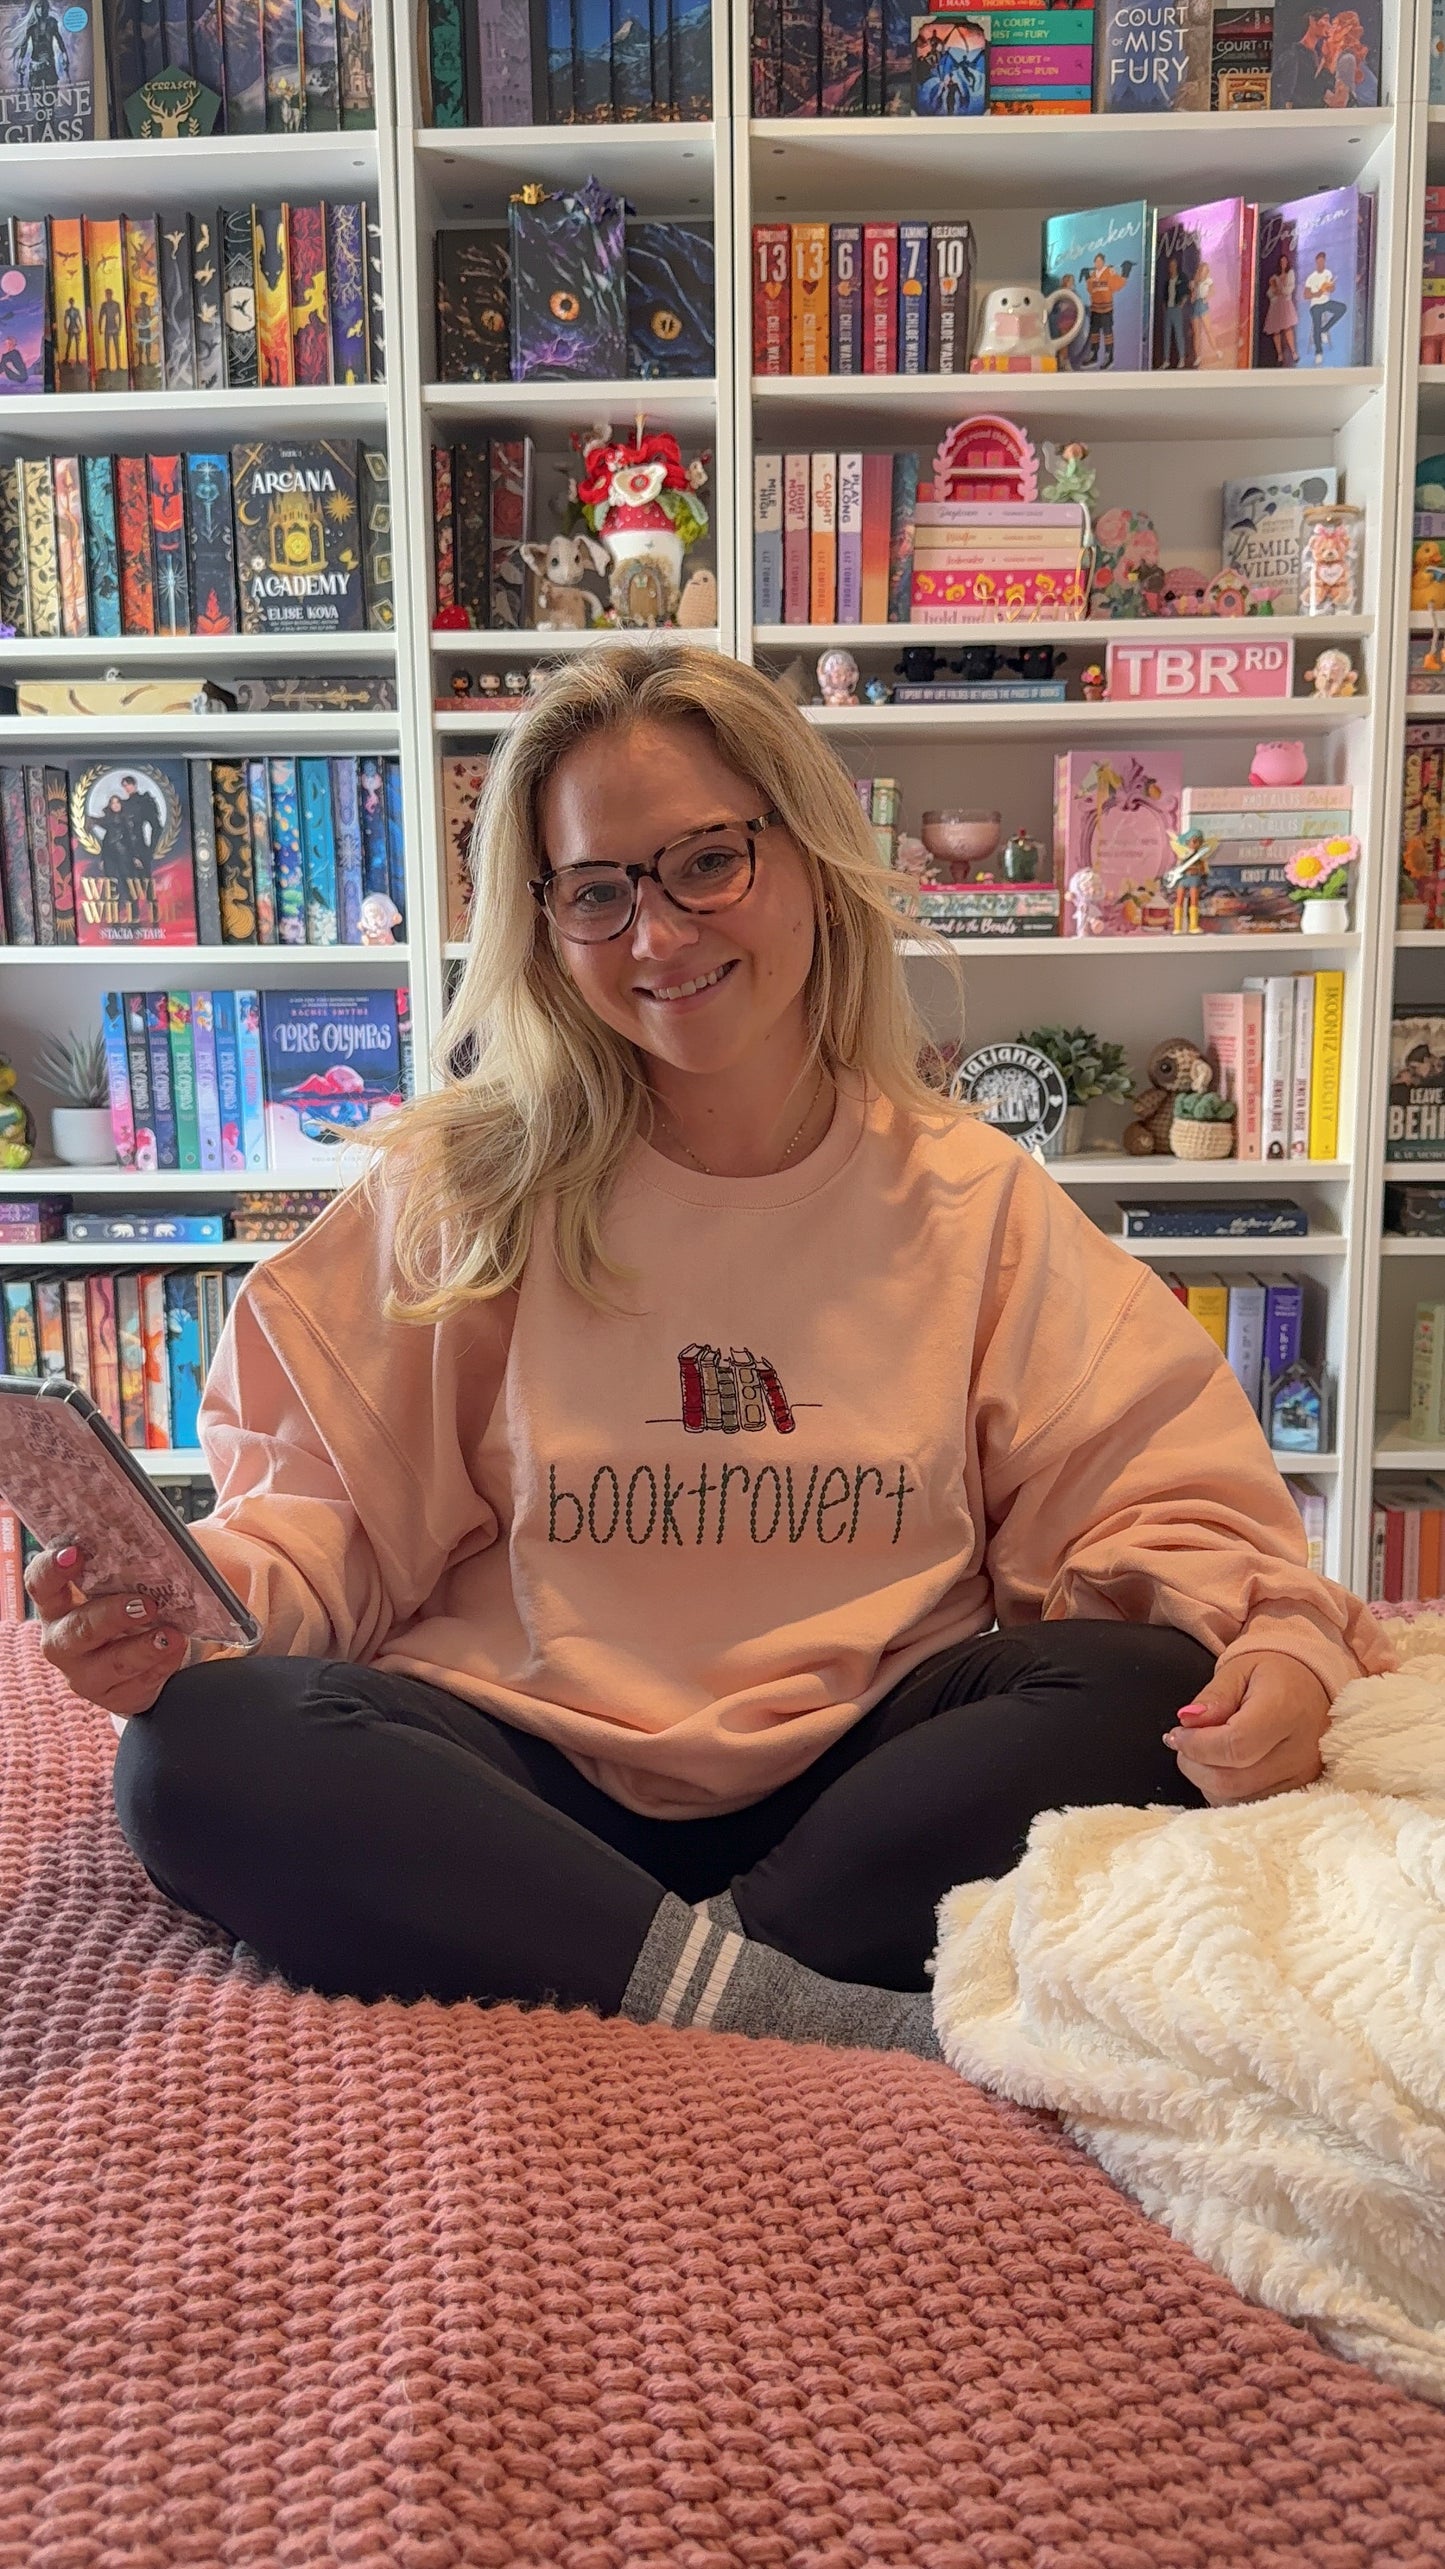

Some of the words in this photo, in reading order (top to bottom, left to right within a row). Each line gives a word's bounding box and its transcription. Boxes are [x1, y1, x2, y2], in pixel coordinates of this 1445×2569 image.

[994, 19, 1000, 27] A
[1003, 18, 1036, 27] COURT
[1115, 7, 1189, 27] COURT
[1024, 30, 1049, 39] FURY
[1111, 38, 1124, 46] OF
[1125, 29, 1189, 53] MIST
[1216, 40, 1257, 52] COURT
[996, 56, 1002, 64] A
[1007, 55, 1042, 64] COURT
[1034, 67, 1059, 76] RUIN
[1110, 56, 1190, 85] FURY
[0, 86, 92, 125] THRONE
[35, 109, 53, 122] OF
[4, 118, 84, 143] GLASS
[758, 244, 787, 282] 13
[796, 242, 823, 280] 13
[838, 242, 854, 280] 6
[873, 242, 889, 280] 6
[905, 241, 921, 279] 7
[937, 240, 964, 279] 10
[251, 468, 337, 495] ARCANA
[851, 474, 860, 506] PLAY
[760, 489, 768, 519] HIGH
[789, 479, 797, 515] MOVE
[797, 484, 805, 523] RIGHT
[815, 490, 824, 508] UP
[823, 473, 832, 525] CAUGHT
[842, 479, 851, 523] ALONG
[251, 573, 351, 598] ACADEMY
[267, 605, 304, 621] ELISE
[307, 605, 339, 620] KOVA
[1118, 648, 1240, 696] TBR
[1245, 647, 1284, 671] RD
[81, 877, 120, 900] WE
[81, 901, 140, 924] WILL
[100, 927, 133, 940] STACIA
[135, 927, 166, 940] STARK
[1322, 995, 1339, 1052] KOONTZ
[272, 1022, 321, 1053] LORE
[322, 1022, 392, 1060] OLYMPUS
[961, 1047, 1053, 1081] Tatiana's
[1409, 1087, 1443, 1104] LEAVE
[548, 1462, 915, 1547] booktrovert
